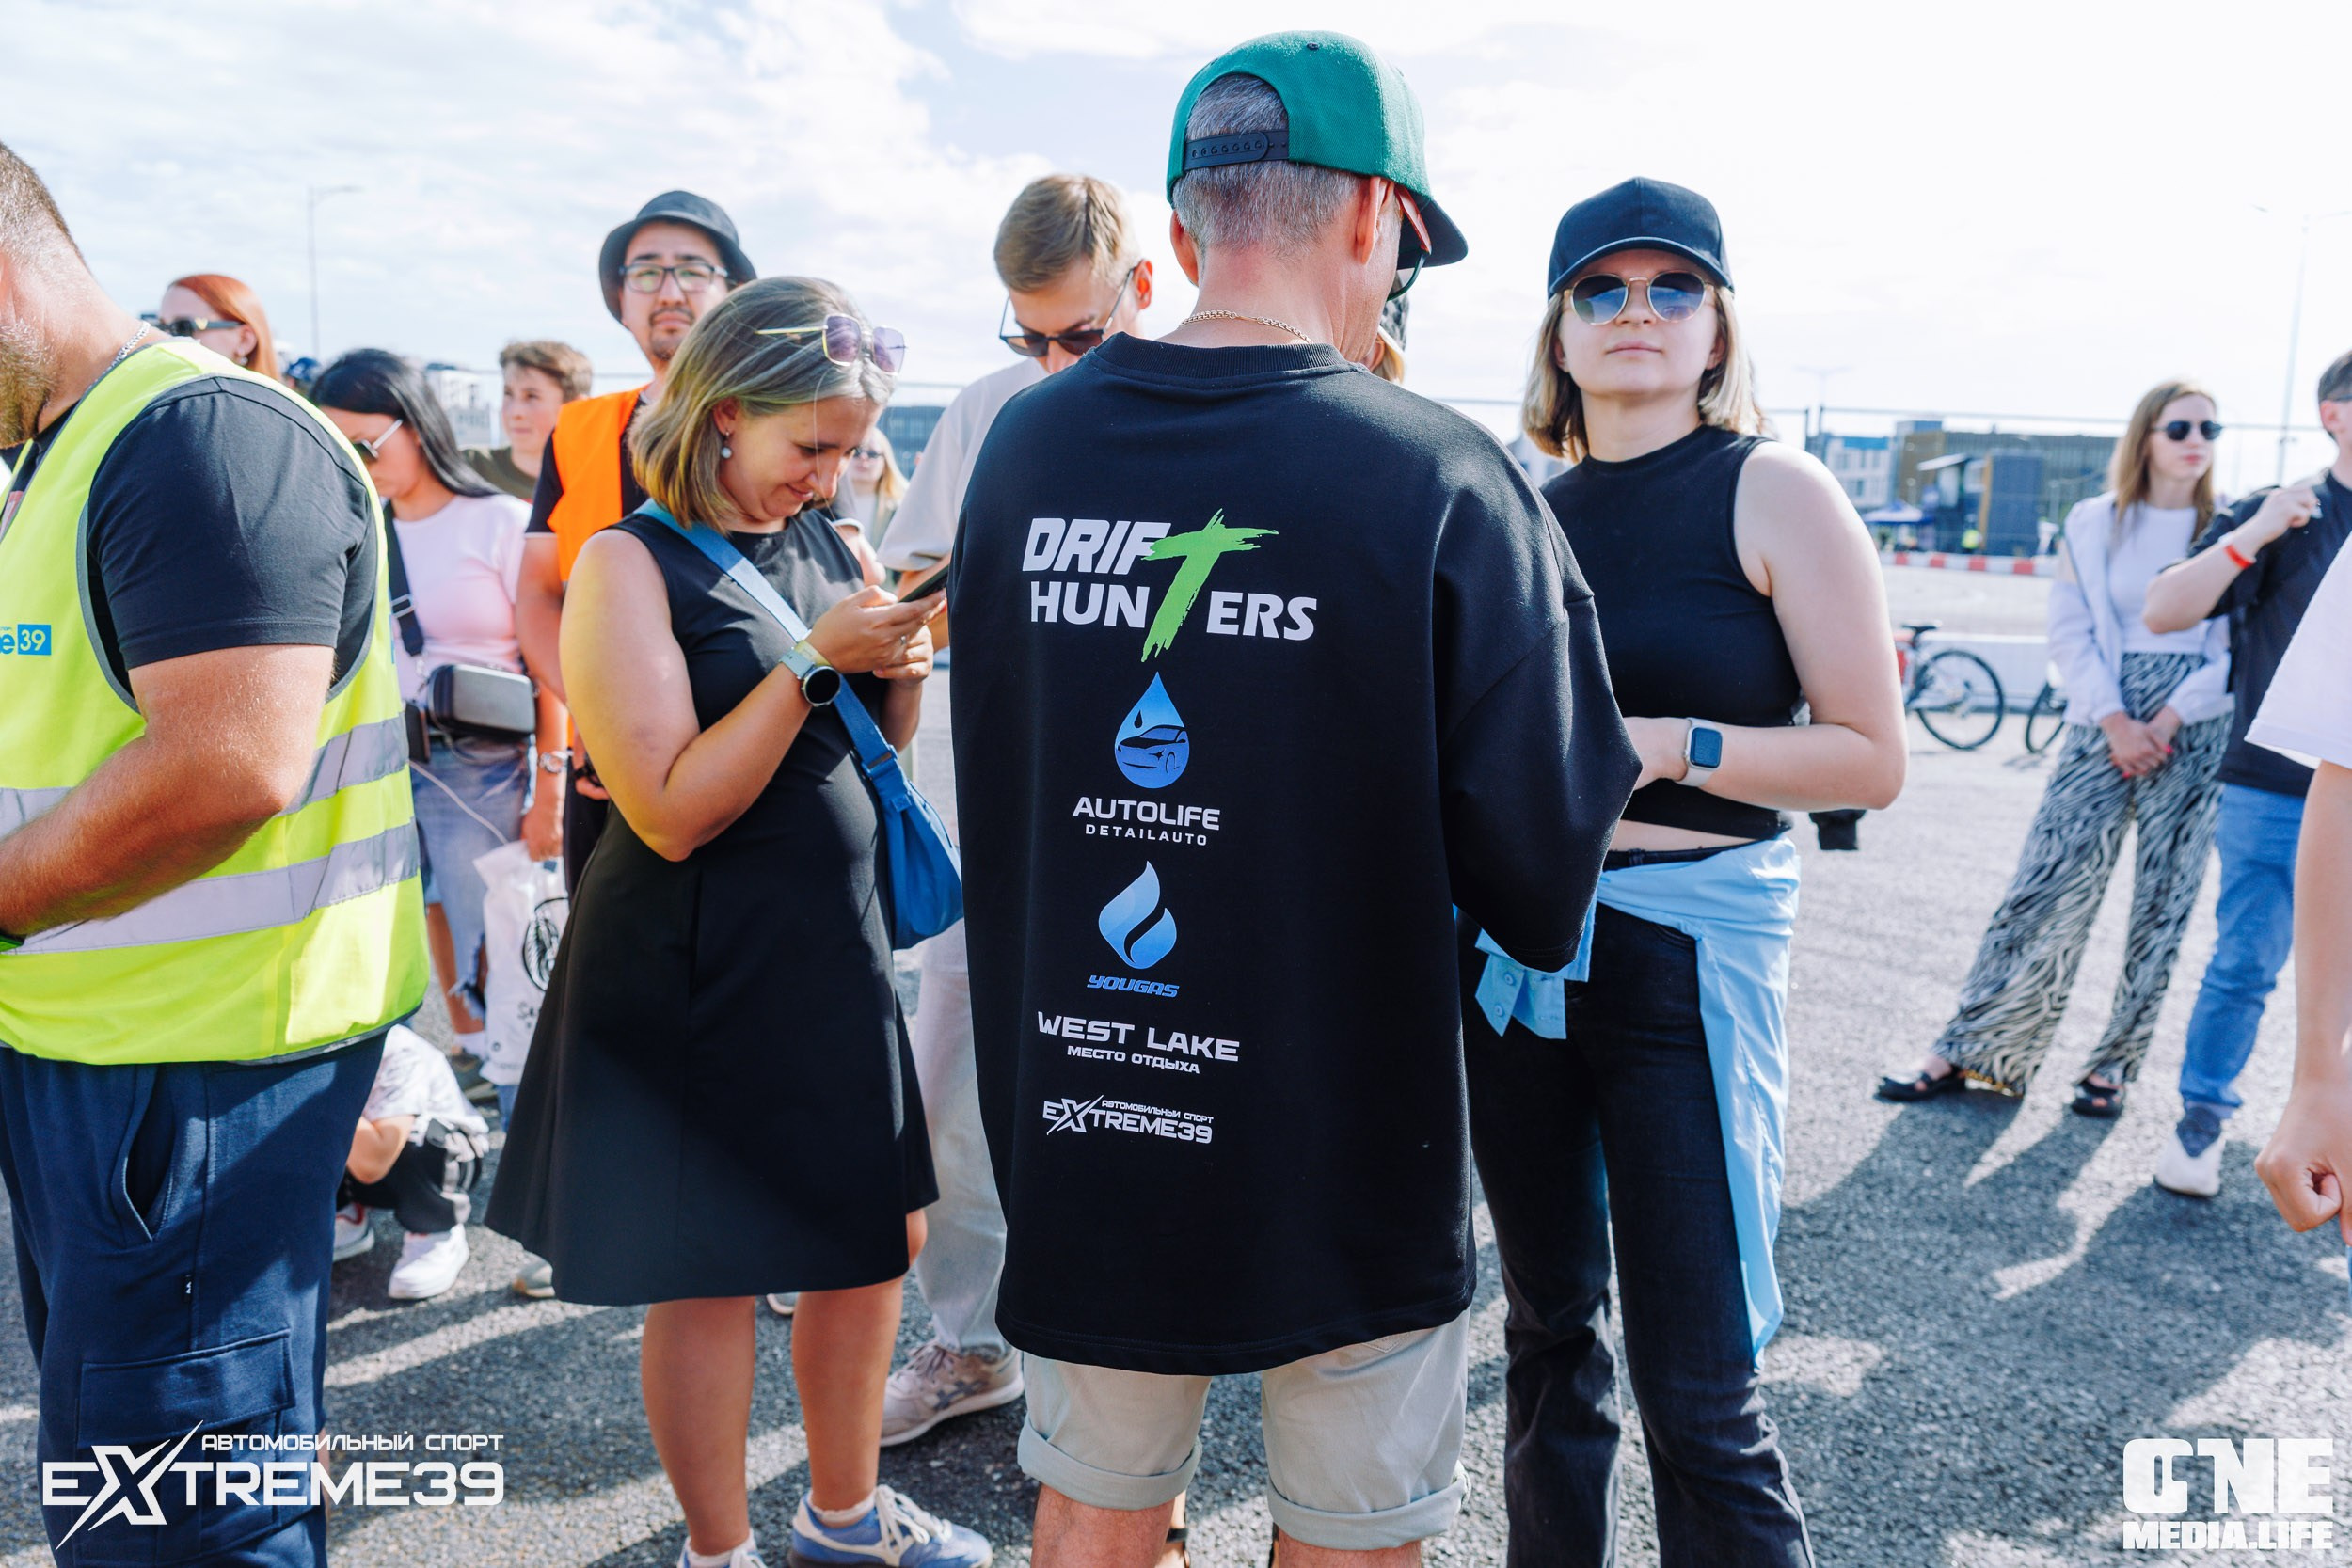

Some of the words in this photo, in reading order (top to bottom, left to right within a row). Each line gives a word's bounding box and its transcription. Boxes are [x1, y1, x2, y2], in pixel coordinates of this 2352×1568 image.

[1073, 797, 1220, 830] AUTOLIFE
[1086, 824, 1207, 846] DETAILAUTO
[1087, 974, 1180, 997] YOUGAS
[1038, 1011, 1135, 1044] WEST
[1147, 1027, 1240, 1062] LAKE
[1067, 1045, 1126, 1062] МЕСТО
[1131, 1053, 1200, 1074] ОТДЫХА
[1042, 1095, 1213, 1144] EXTREME39
[1184, 1112, 1214, 1124] СПОРТ
